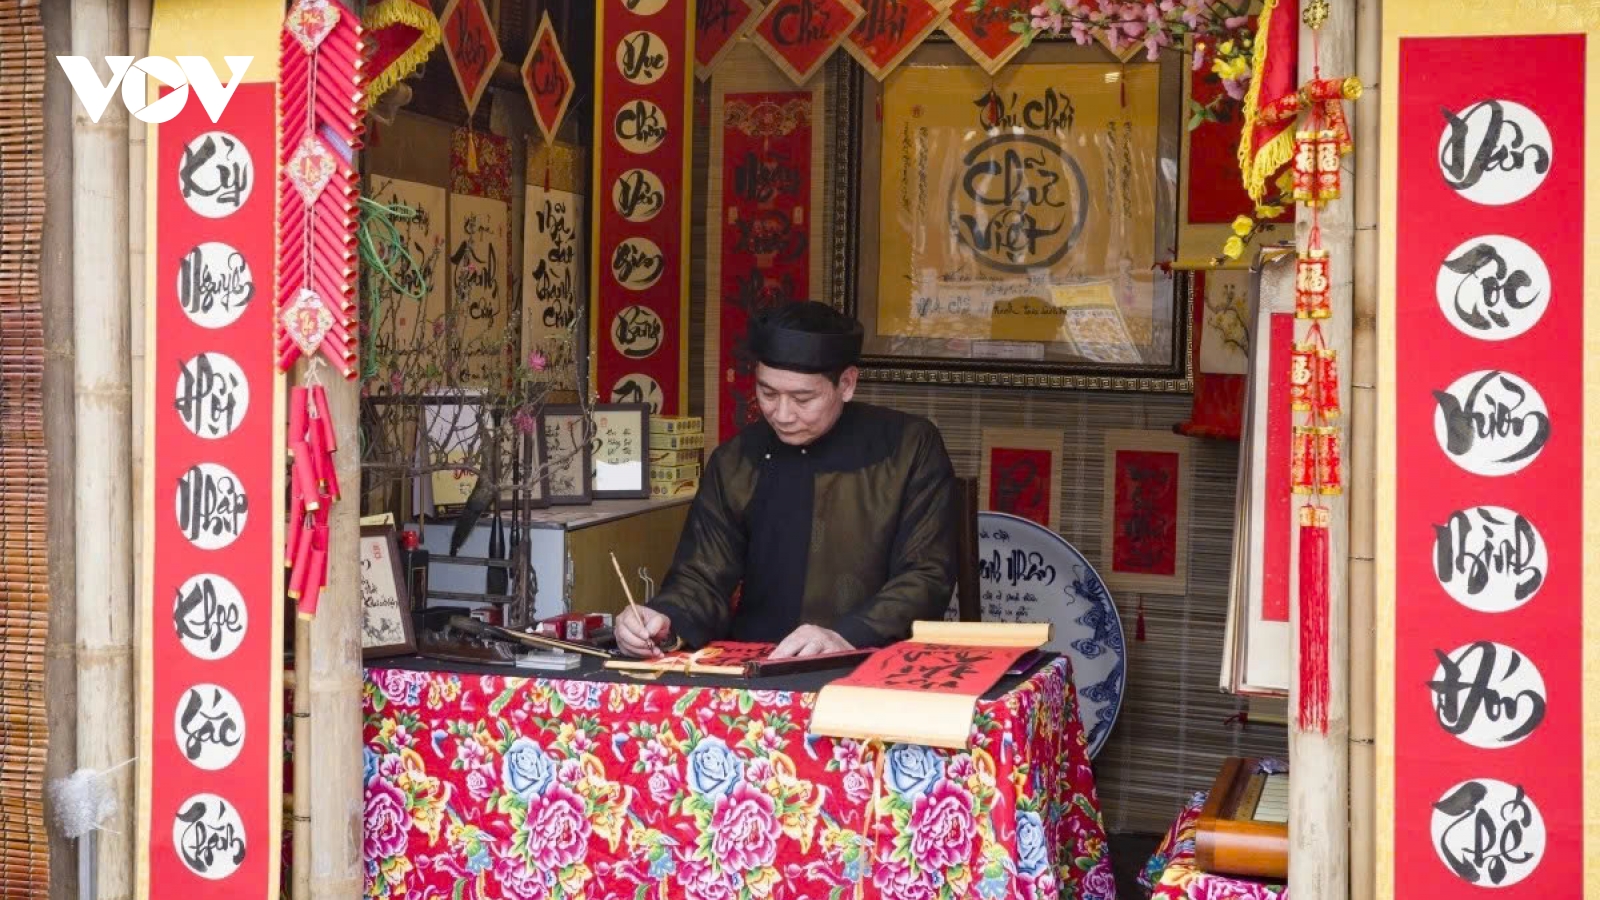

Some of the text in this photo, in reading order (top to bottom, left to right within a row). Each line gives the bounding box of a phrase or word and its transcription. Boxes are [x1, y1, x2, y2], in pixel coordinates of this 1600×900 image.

[179, 135, 249, 208] Kỷ
[962, 148, 1067, 211] Chữ
[1439, 98, 1551, 191] Dân
[958, 208, 1066, 264] Việt
[178, 246, 254, 314] Nguyên
[1441, 242, 1542, 331] Tộc
[174, 352, 241, 435] Hội
[1430, 369, 1553, 464] Vươn
[176, 464, 249, 541] Nhập
[1006, 549, 1057, 587] Nhân
[172, 577, 243, 653] Khoe
[180, 687, 242, 761] Sắc
[1424, 640, 1547, 742] Đón
[1431, 781, 1536, 885] Thế
